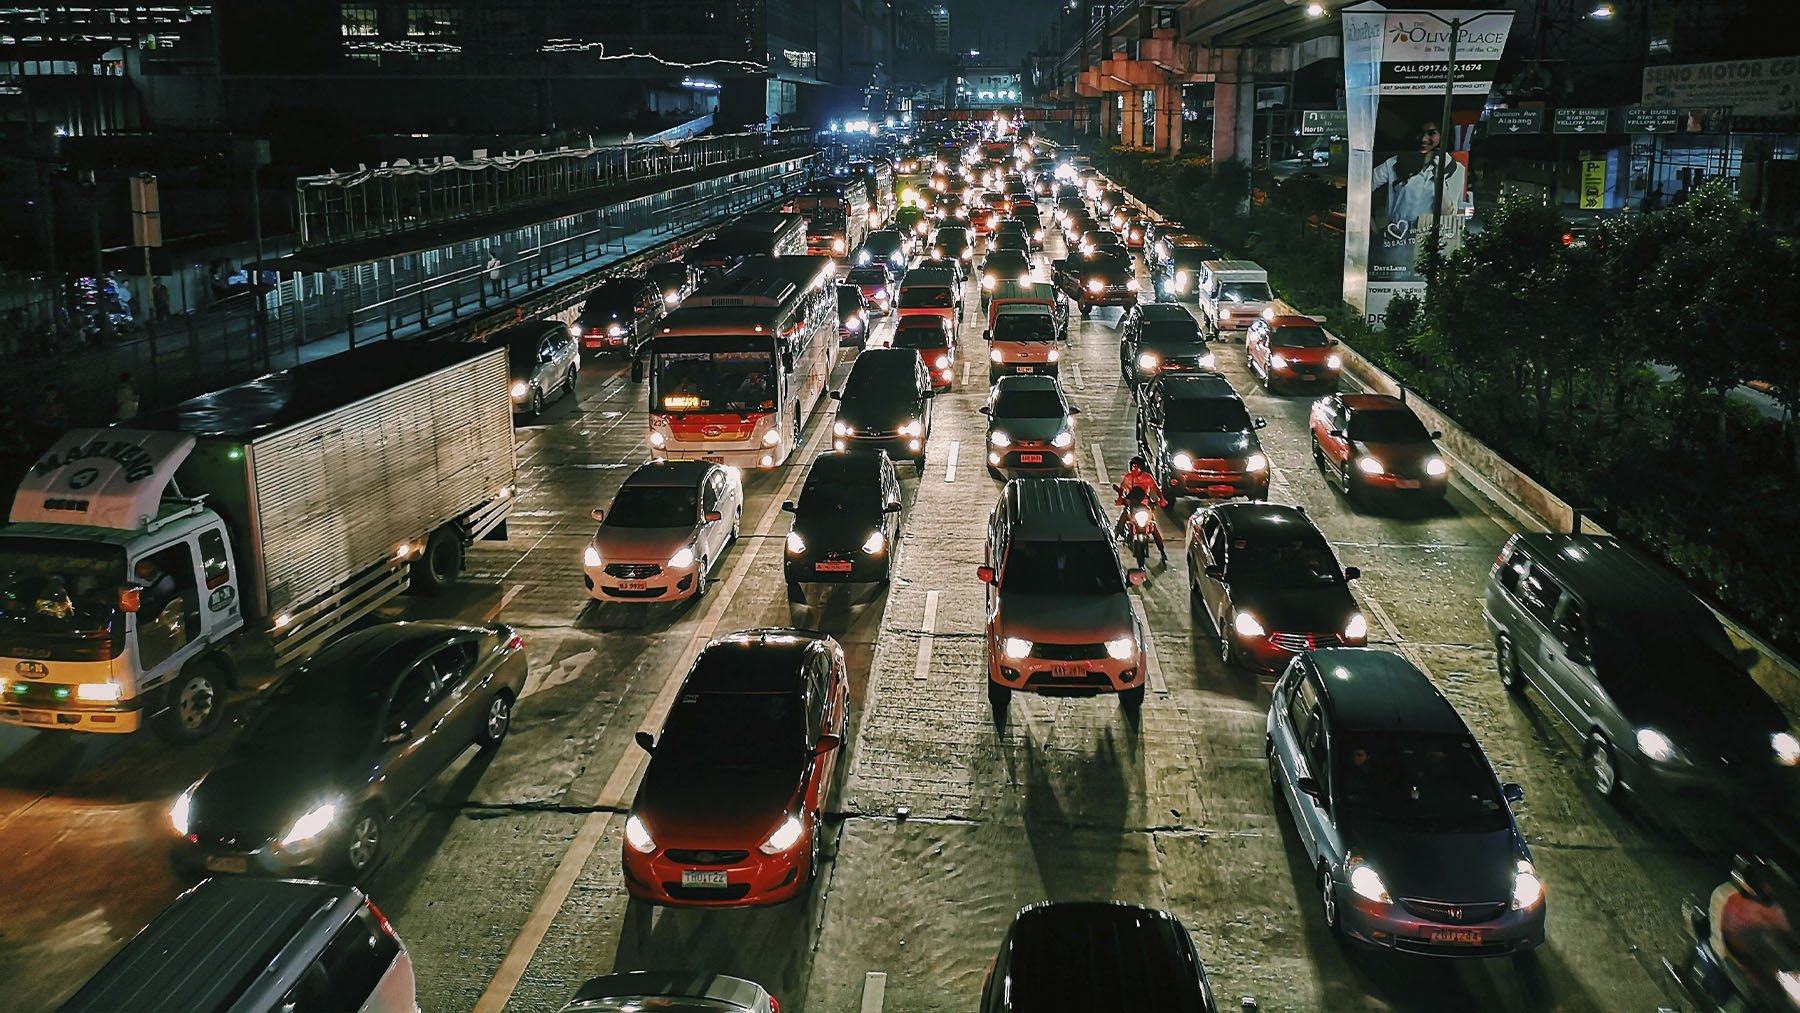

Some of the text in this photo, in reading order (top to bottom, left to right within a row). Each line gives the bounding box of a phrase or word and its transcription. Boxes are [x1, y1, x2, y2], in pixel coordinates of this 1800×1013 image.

[1394, 63, 1482, 73] CALL 0917.69.1674
[1699, 62, 1763, 80] MOTOR
[1498, 117, 1532, 125] Alabang
[1368, 313, 1386, 323] DR
